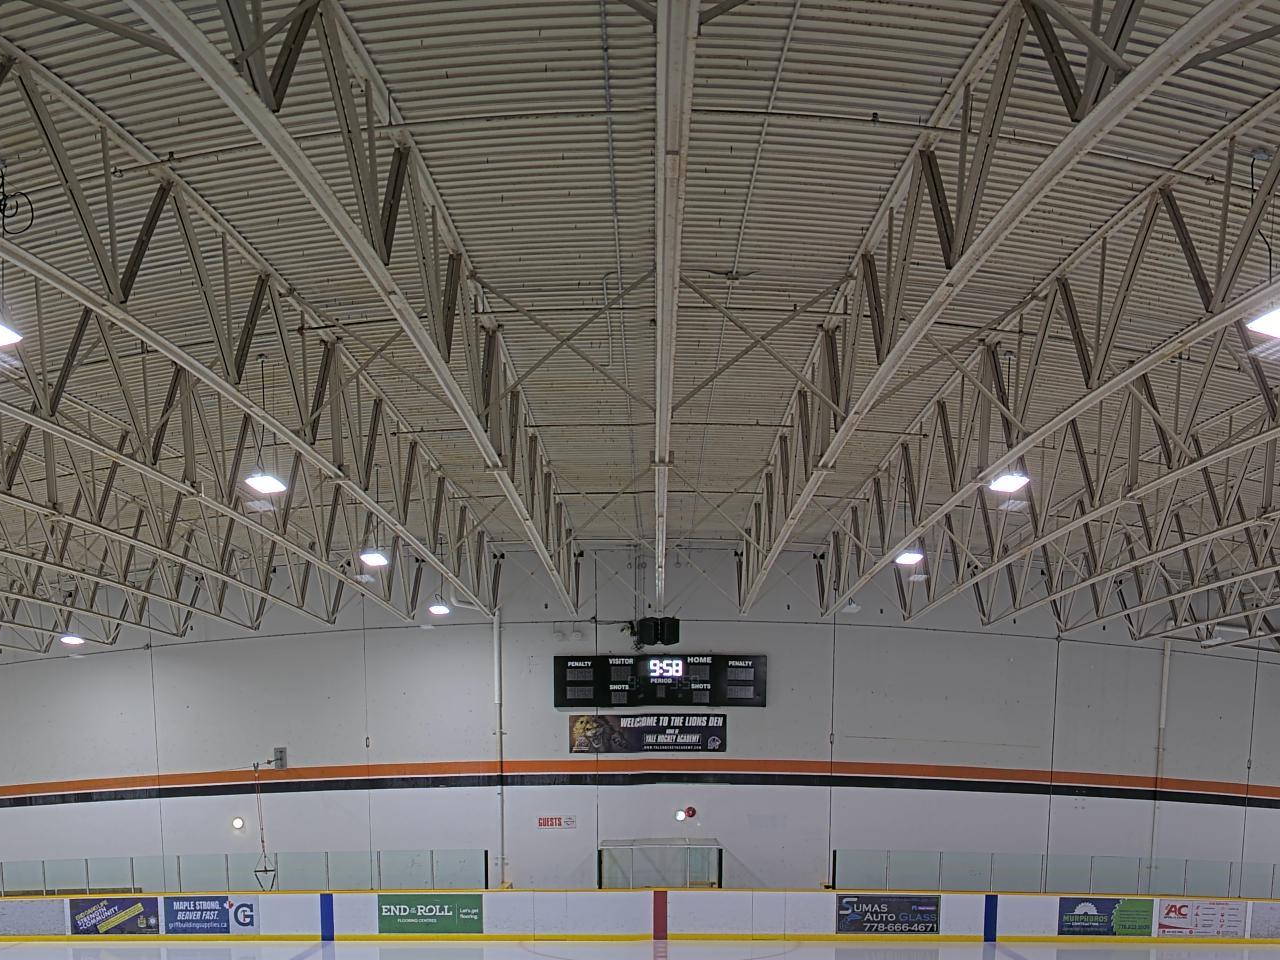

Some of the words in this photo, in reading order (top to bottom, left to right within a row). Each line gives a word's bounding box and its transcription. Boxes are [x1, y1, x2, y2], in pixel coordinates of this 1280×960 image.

[649, 659, 683, 677] 9:58
[620, 717, 658, 728] WELCOME
[659, 717, 669, 727] TO
[670, 717, 683, 727] THE
[685, 716, 707, 727] LIONS
[709, 716, 723, 727] DEN
[538, 817, 562, 827] GUESTS
[173, 901, 195, 910] MAPLE
[196, 901, 221, 910] STRONG.
[381, 905, 410, 916] END
[416, 905, 453, 916] ROLL
[839, 897, 888, 914] SUMAS
[177, 911, 201, 920] BEAVER
[202, 911, 219, 920] FAST.
[863, 913, 896, 921] AUTO
[898, 912, 937, 921] GLASS
[863, 923, 937, 932] 778-666-4671
